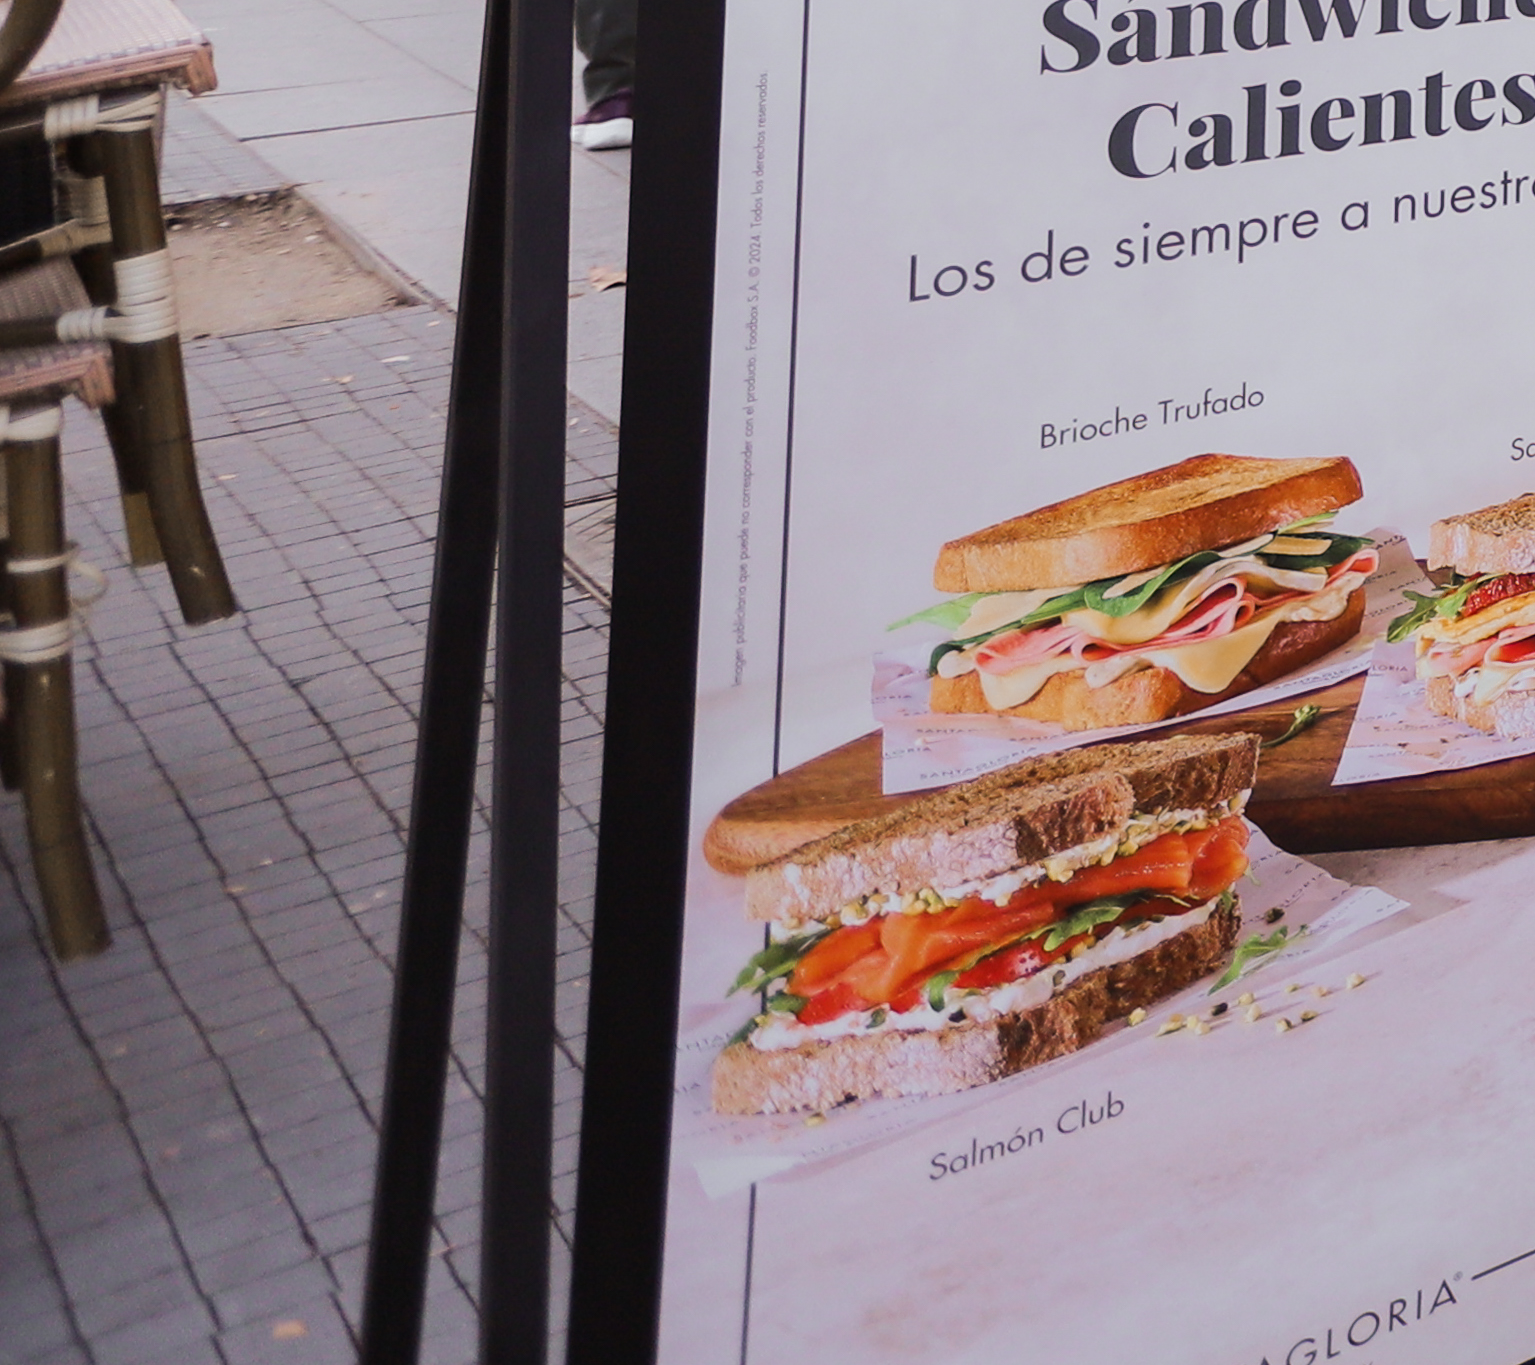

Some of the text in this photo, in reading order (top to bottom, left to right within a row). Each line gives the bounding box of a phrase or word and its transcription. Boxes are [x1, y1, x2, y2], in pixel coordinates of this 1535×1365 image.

[752, 131, 765, 177] derechos
[751, 180, 764, 195] los
[750, 198, 762, 228] Todos
[910, 255, 994, 301] Los
[1021, 230, 1089, 282] de
[1115, 210, 1318, 268] siempre
[1341, 202, 1368, 230] a
[745, 306, 758, 351] Foodbox
[745, 418, 753, 437] con
[1041, 382, 1264, 449] Brioche Trufado
[741, 441, 754, 508] corresponder
[738, 528, 750, 560] puede
[739, 564, 749, 583] que
[731, 648, 746, 687] Imagen
[930, 1127, 1043, 1180] Salmón
[1057, 1091, 1124, 1134] Club
[1261, 1279, 1458, 1365] GLORIA
